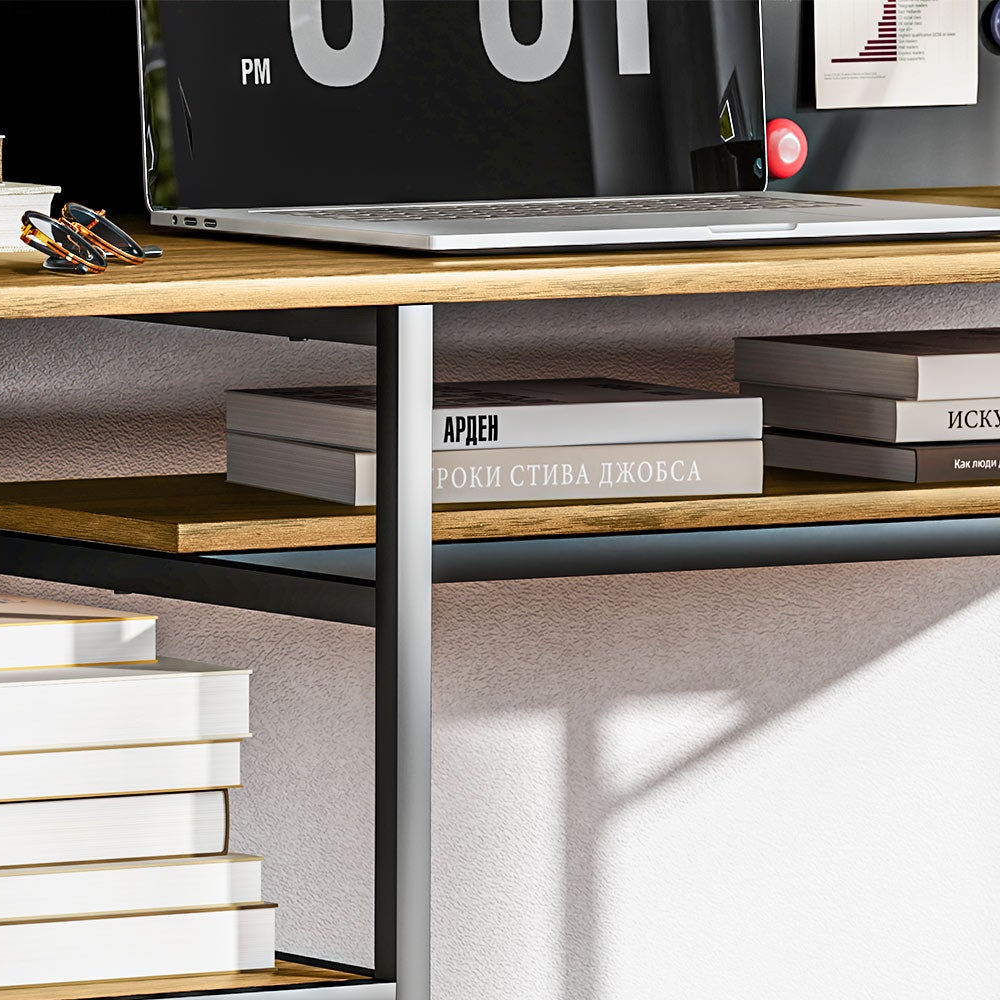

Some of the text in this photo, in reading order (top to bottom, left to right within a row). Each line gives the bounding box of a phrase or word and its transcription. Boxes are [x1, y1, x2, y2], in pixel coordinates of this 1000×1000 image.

[241, 58, 271, 85] PM
[443, 414, 499, 446] АРДЕН
[432, 460, 701, 489] РОКИ СТИВА ДЖОБСА
[954, 458, 997, 469] Как люди
